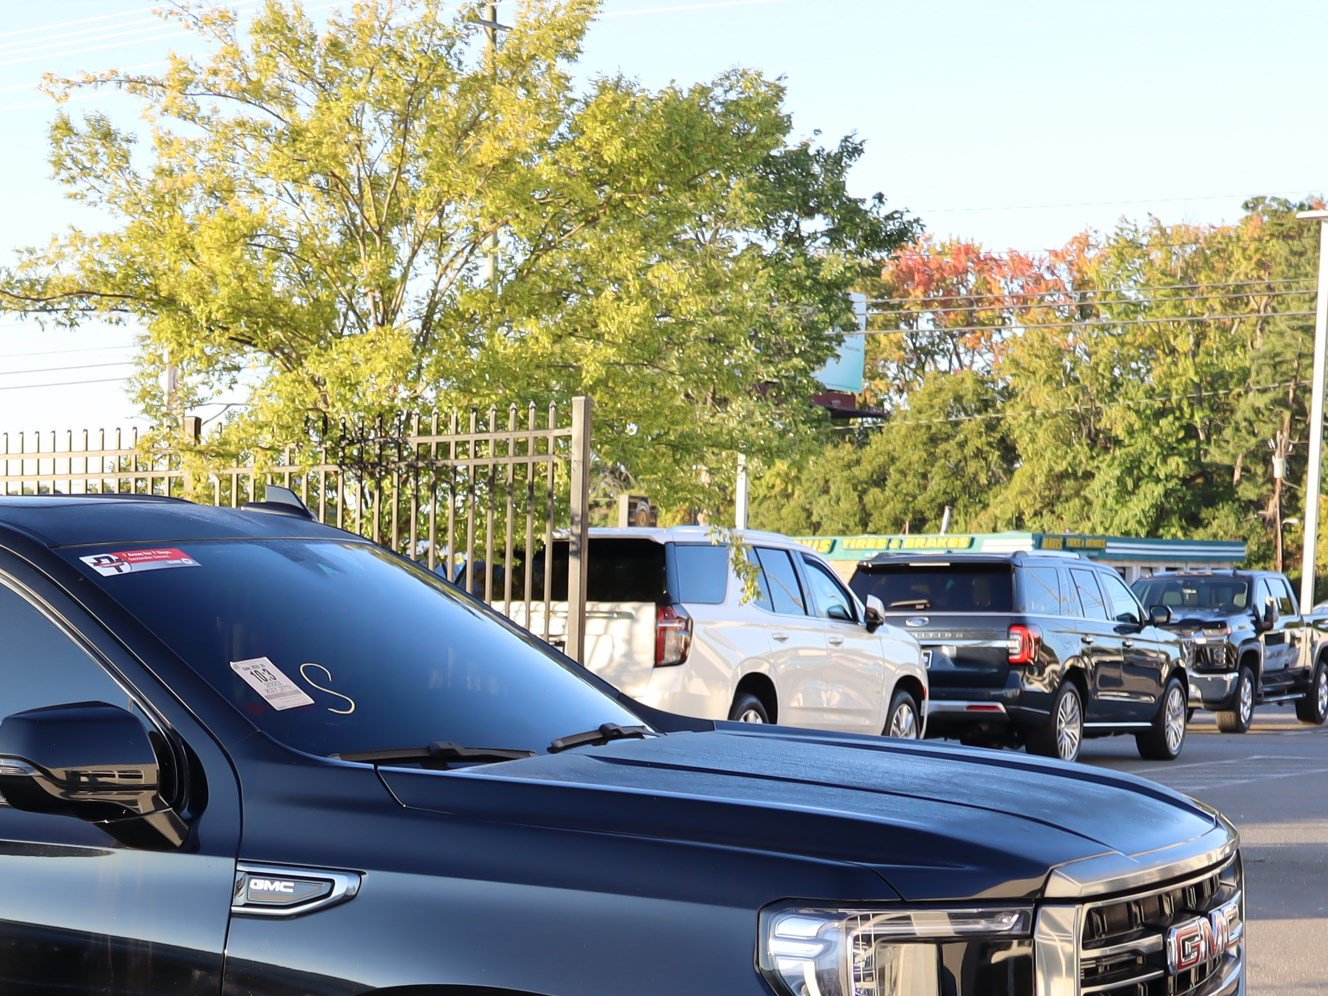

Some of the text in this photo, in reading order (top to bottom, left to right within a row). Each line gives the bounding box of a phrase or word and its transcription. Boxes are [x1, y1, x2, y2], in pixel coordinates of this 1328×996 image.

[842, 537, 889, 549] TIRES
[903, 536, 972, 549] BRAKES
[300, 663, 355, 714] S
[249, 879, 294, 892] GMC
[1169, 903, 1243, 974] GMC
